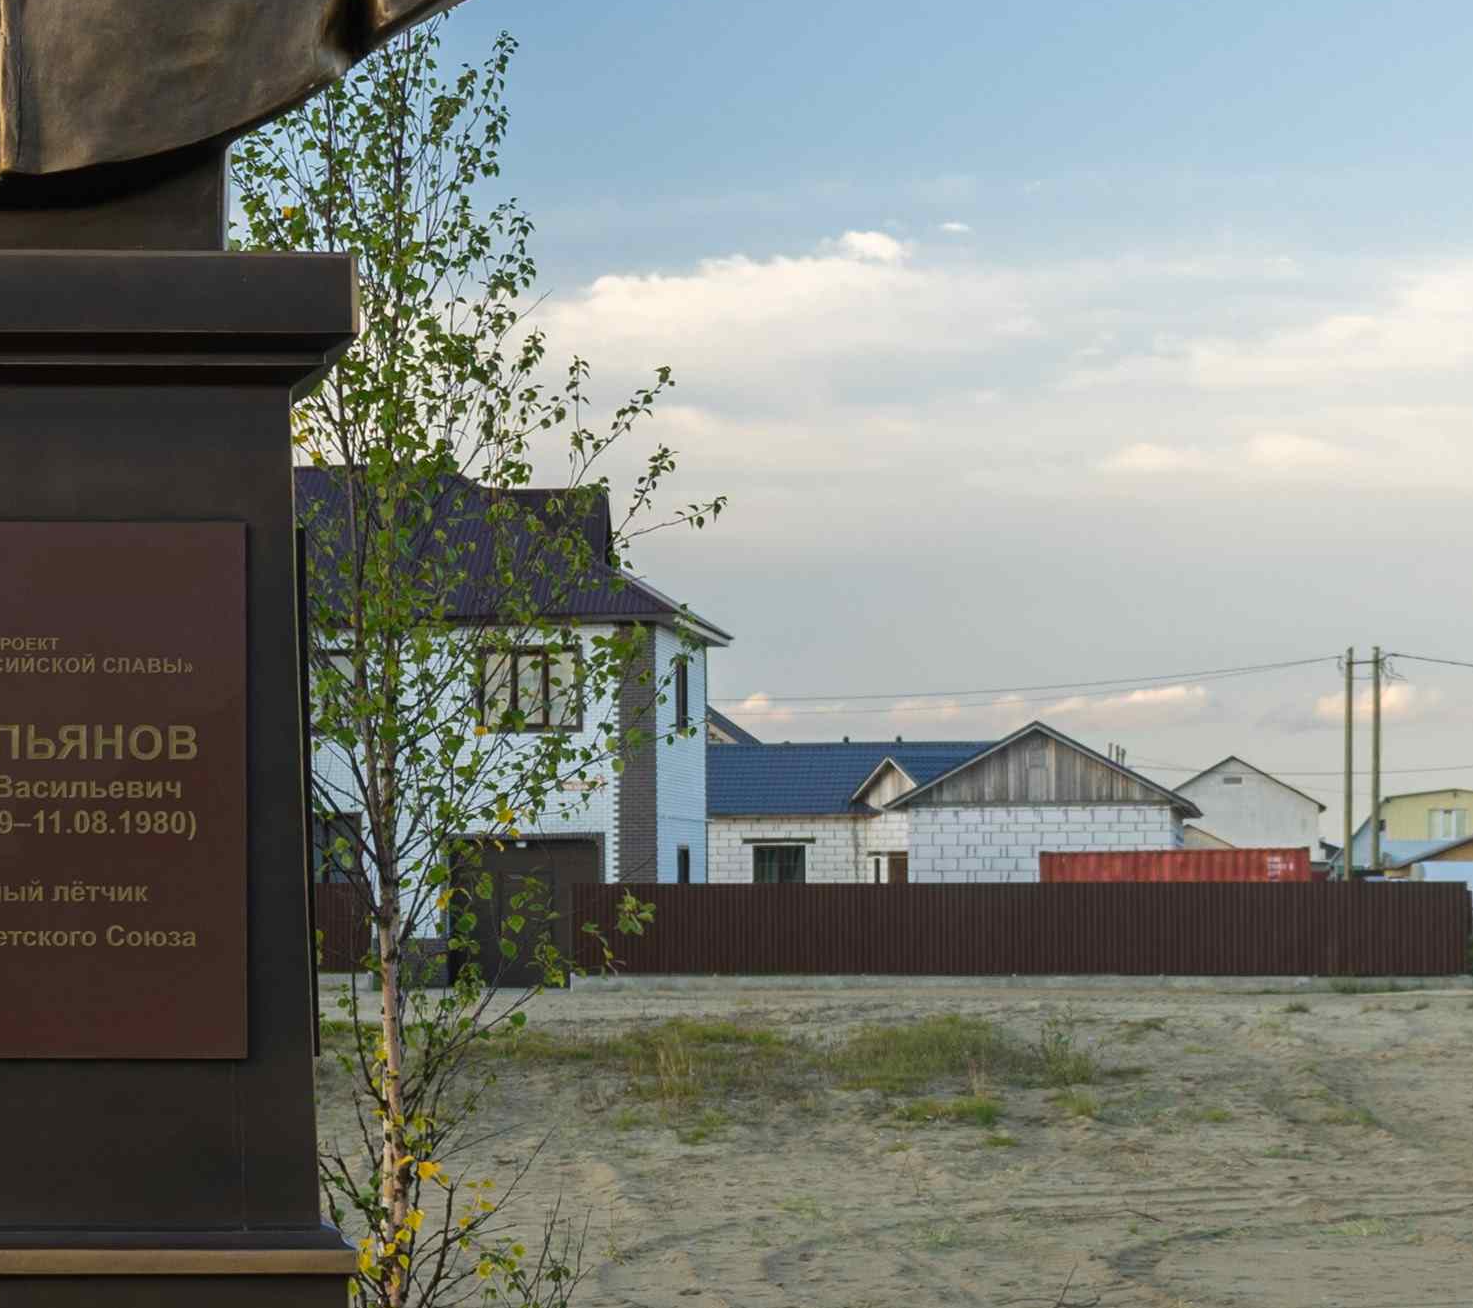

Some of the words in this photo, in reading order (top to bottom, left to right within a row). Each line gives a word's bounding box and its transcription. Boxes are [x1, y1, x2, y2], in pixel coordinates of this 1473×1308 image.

[102, 656, 194, 675] СЛАВЫ»
[52, 882, 149, 903] лётчик
[105, 926, 197, 948] Союза
